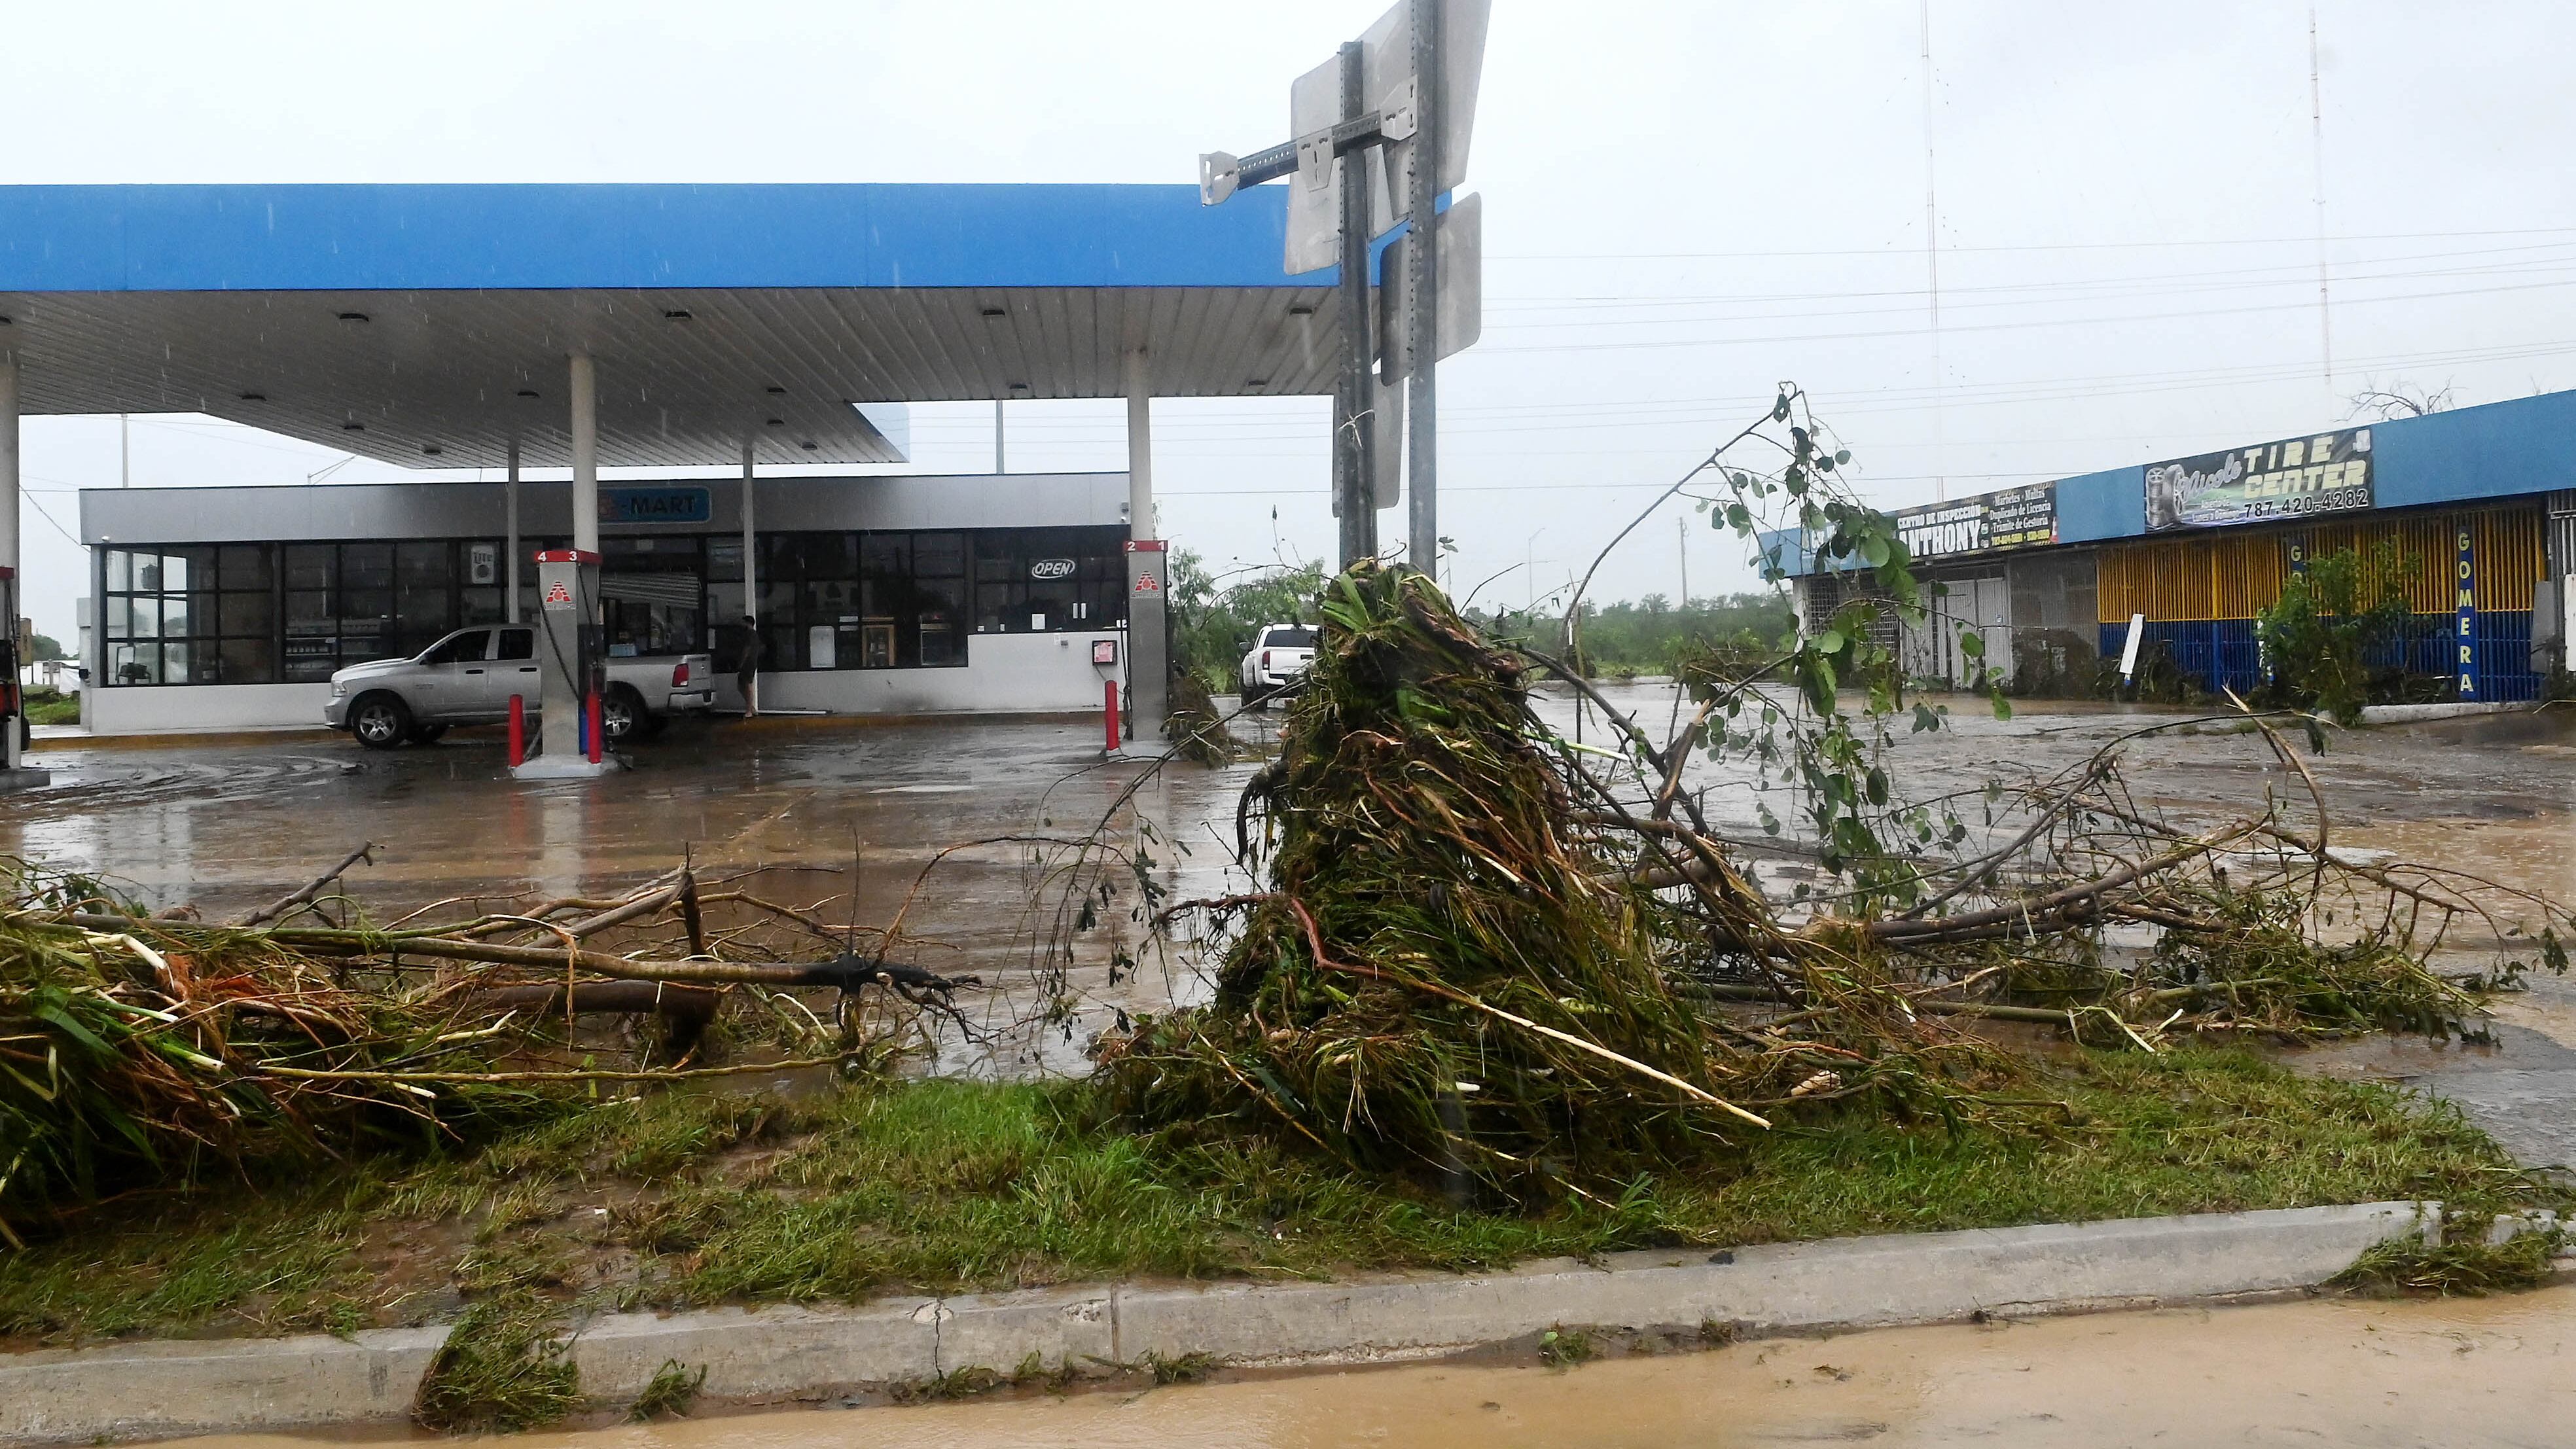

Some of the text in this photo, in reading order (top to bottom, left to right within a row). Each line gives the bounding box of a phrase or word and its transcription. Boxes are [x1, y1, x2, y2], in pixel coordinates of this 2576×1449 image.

[2244, 435, 2334, 473] TIRE
[2244, 460, 2367, 499] CENTER
[2018, 503, 2026, 516] de
[2026, 499, 2051, 514] Licencia
[1926, 512, 1936, 525] DE
[2016, 518, 2022, 529] de
[1128, 541, 1164, 551] 2 1
[538, 551, 577, 562] 4 3
[1035, 562, 1071, 575] OPEN
[2458, 533, 2474, 692] GOMERA
